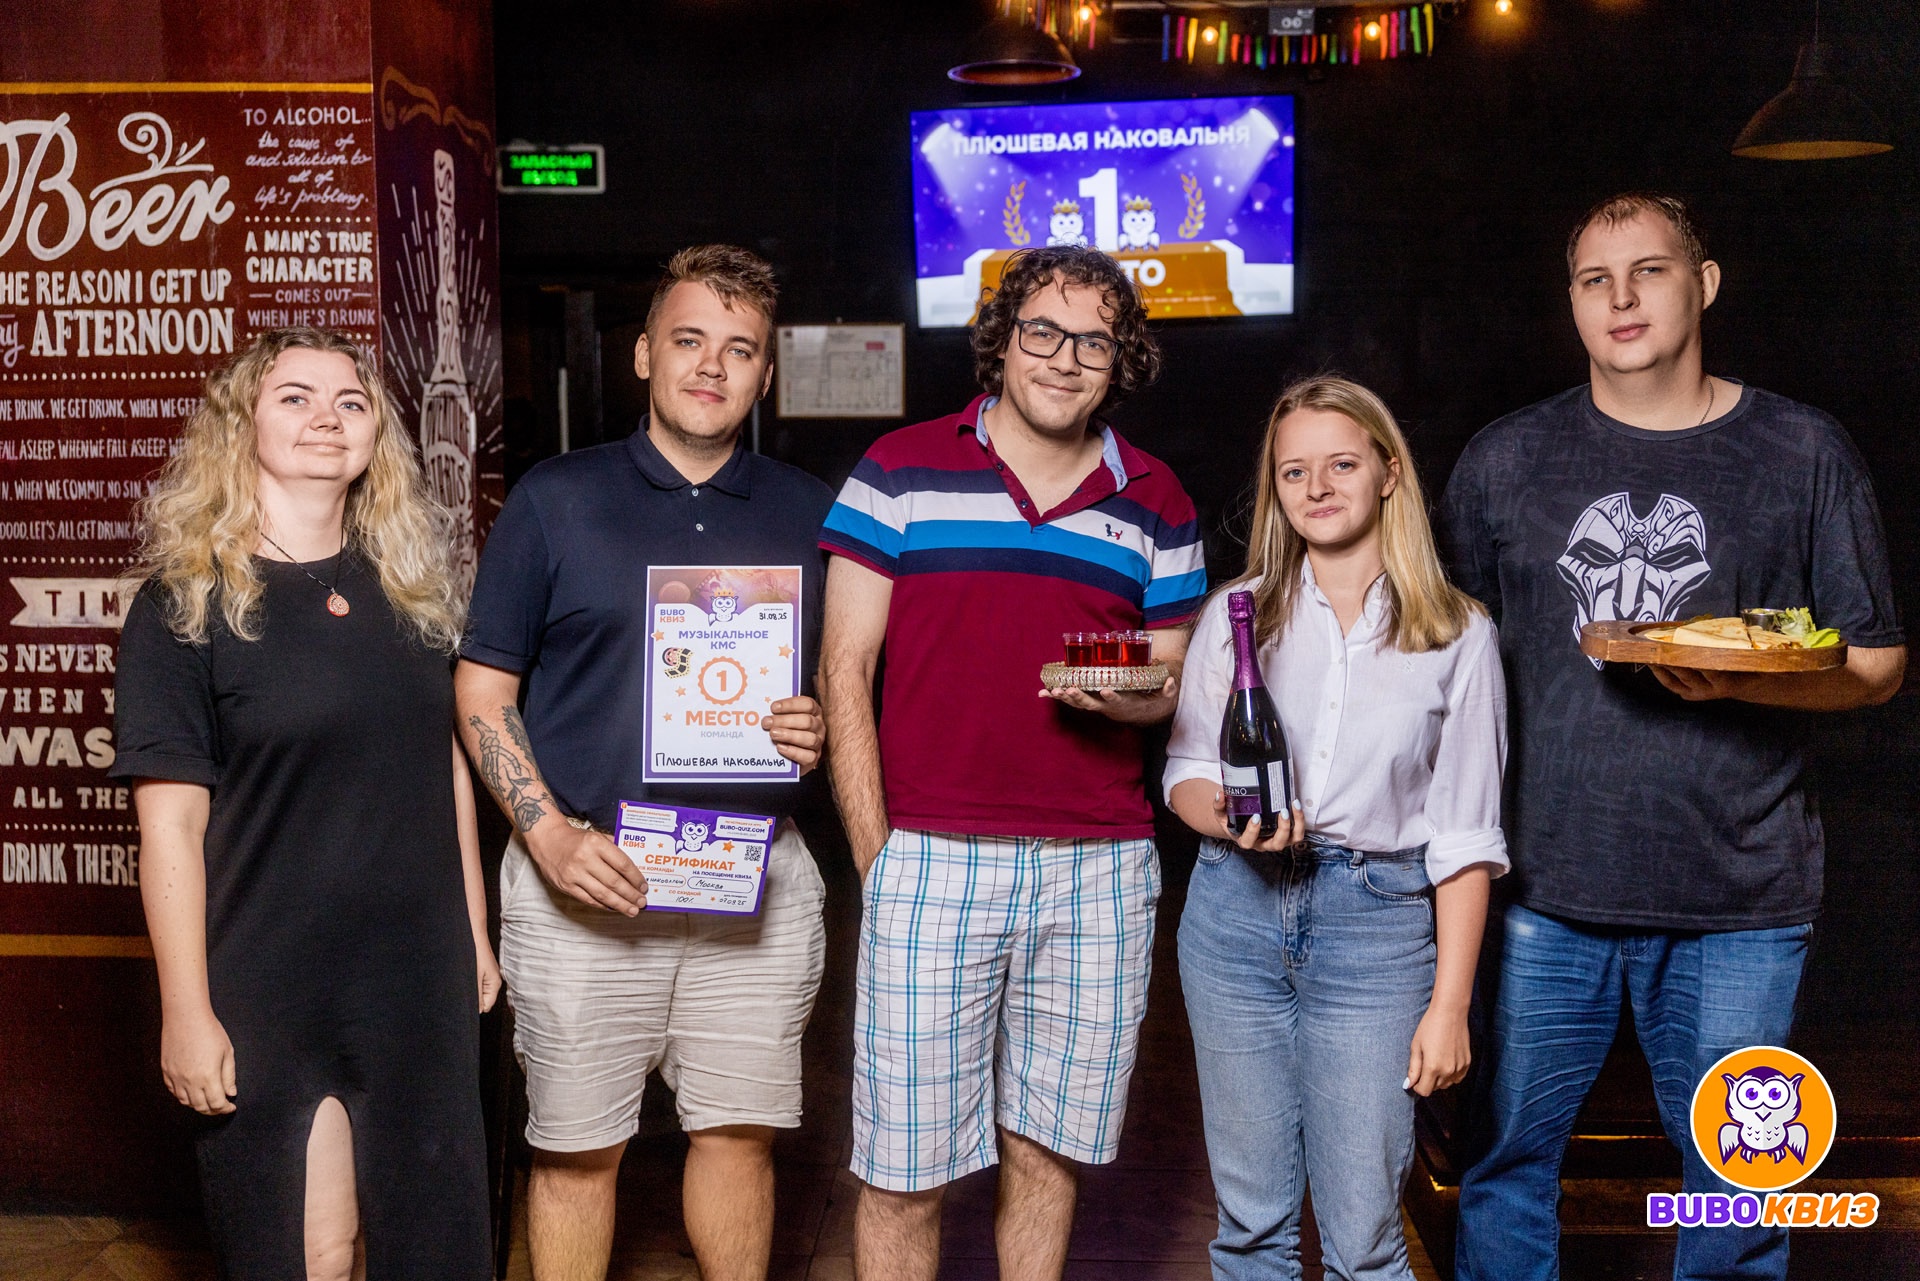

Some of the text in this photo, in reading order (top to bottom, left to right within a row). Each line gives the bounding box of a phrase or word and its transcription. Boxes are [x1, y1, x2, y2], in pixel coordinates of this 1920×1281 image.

[244, 108, 267, 126] TO
[258, 130, 355, 151] the cause of
[953, 125, 1250, 156] ПЛЮШЕВАЯ НАКОВАЛЬНЯ
[245, 148, 372, 167] and solution to
[288, 169, 334, 188] all of
[1078, 168, 1119, 251] 1
[245, 230, 373, 253] A MAN'S TRUE
[246, 256, 374, 283] CHARACTER
[36, 269, 131, 305] REASON
[135, 270, 143, 304] I
[150, 269, 197, 303] GET
[200, 268, 232, 301] UP
[275, 288, 352, 303] COMES OUT
[247, 309, 376, 327] WHEN HE'S DRUNK
[30, 308, 234, 357] AFTERNOON
[51, 398, 66, 420] WE
[68, 398, 88, 419] GET
[130, 398, 158, 418] WHEN
[160, 398, 177, 418] WE
[58, 440, 89, 459] WHEN
[90, 440, 105, 459] WE
[107, 438, 127, 459] FALL
[15, 479, 43, 501] WHEN
[45, 479, 62, 501] WE
[107, 480, 121, 499] NO
[30, 520, 56, 540] LET'S
[58, 520, 75, 540] ALL
[77, 520, 97, 540] GET
[98, 520, 131, 540] DRUNK
[678, 630, 769, 640] МУЗЫКАЛЬНОЕ
[710, 641, 737, 650] КМС
[15, 643, 116, 673] NEVER
[716, 670, 728, 692] 1
[685, 710, 760, 727] МЕСТО
[700, 731, 744, 739] КОМАНДА
[13, 786, 129, 810] ALL THE
[624, 834, 646, 842] BUBO
[720, 824, 765, 833] BUBO-QUIZ.COM
[623, 841, 646, 849] КВИЗ
[2, 842, 67, 884] DRINK
[645, 854, 736, 871] СЕРТИФИКАТ
[701, 871, 733, 879] ПОСЕЩЕНИЕ
